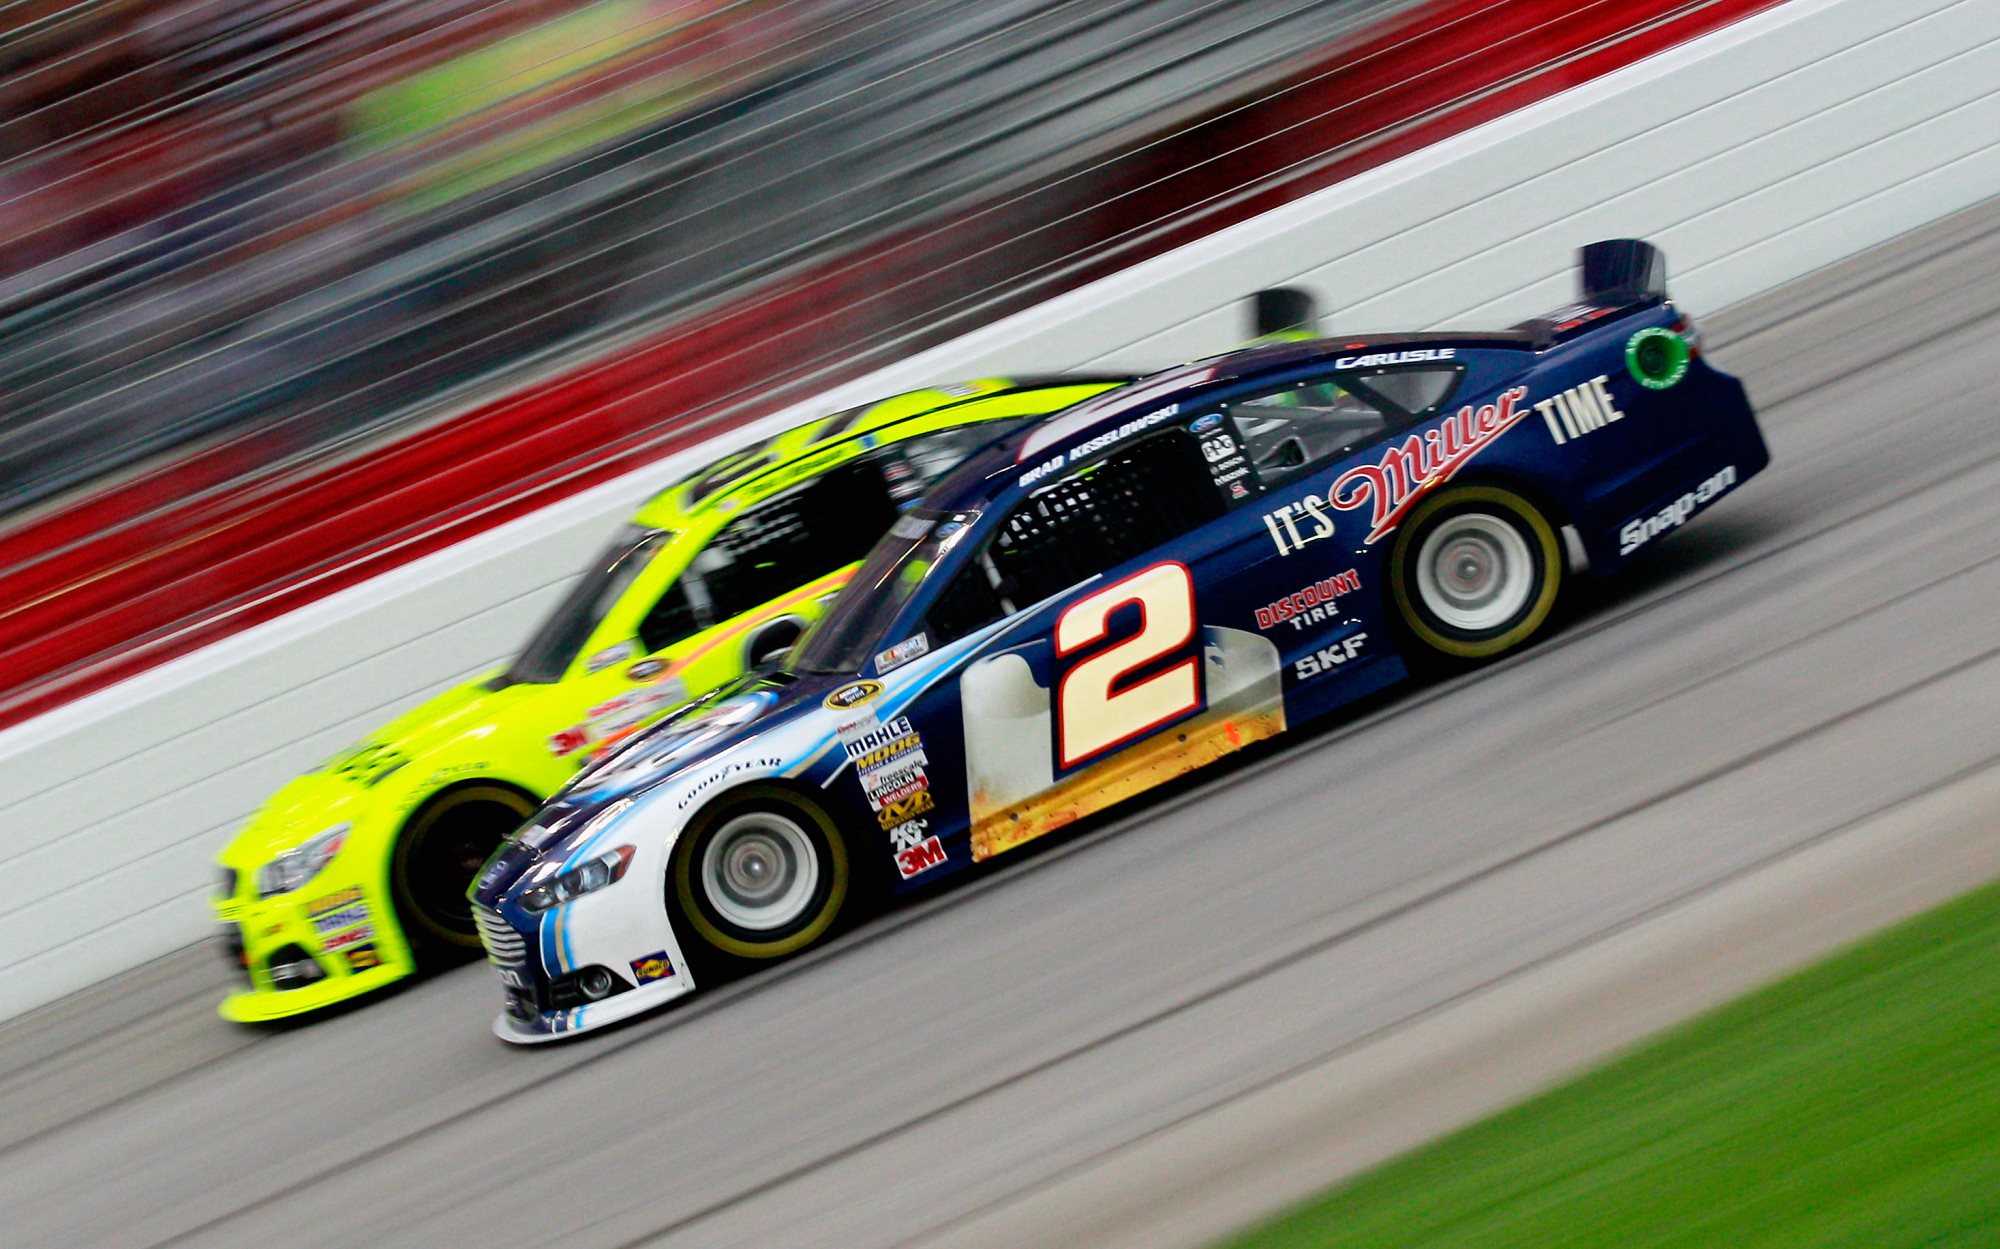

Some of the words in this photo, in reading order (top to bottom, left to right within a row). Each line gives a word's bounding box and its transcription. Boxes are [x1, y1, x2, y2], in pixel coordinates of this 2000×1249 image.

[1335, 348, 1456, 369] CARLISLE
[1535, 374, 1625, 445] TIME
[1019, 455, 1064, 487] BRAD
[1069, 403, 1179, 461] KESELOWSKI
[1203, 437, 1234, 458] PPG
[1329, 385, 1530, 545] Miller
[1263, 494, 1335, 556] IT'S
[1254, 568, 1362, 630] DISCOUNT
[1289, 601, 1339, 630] TIRE
[1054, 560, 1200, 770] 2
[1295, 633, 1368, 680] SKF
[846, 719, 911, 758] MAHLE
[857, 734, 920, 770] MOOG
[678, 758, 782, 810] GOODYEAR
[869, 773, 916, 801] LINCOLN
[880, 760, 923, 785] freescale
[883, 780, 923, 804] WELDERS
[898, 837, 945, 875] 3M
